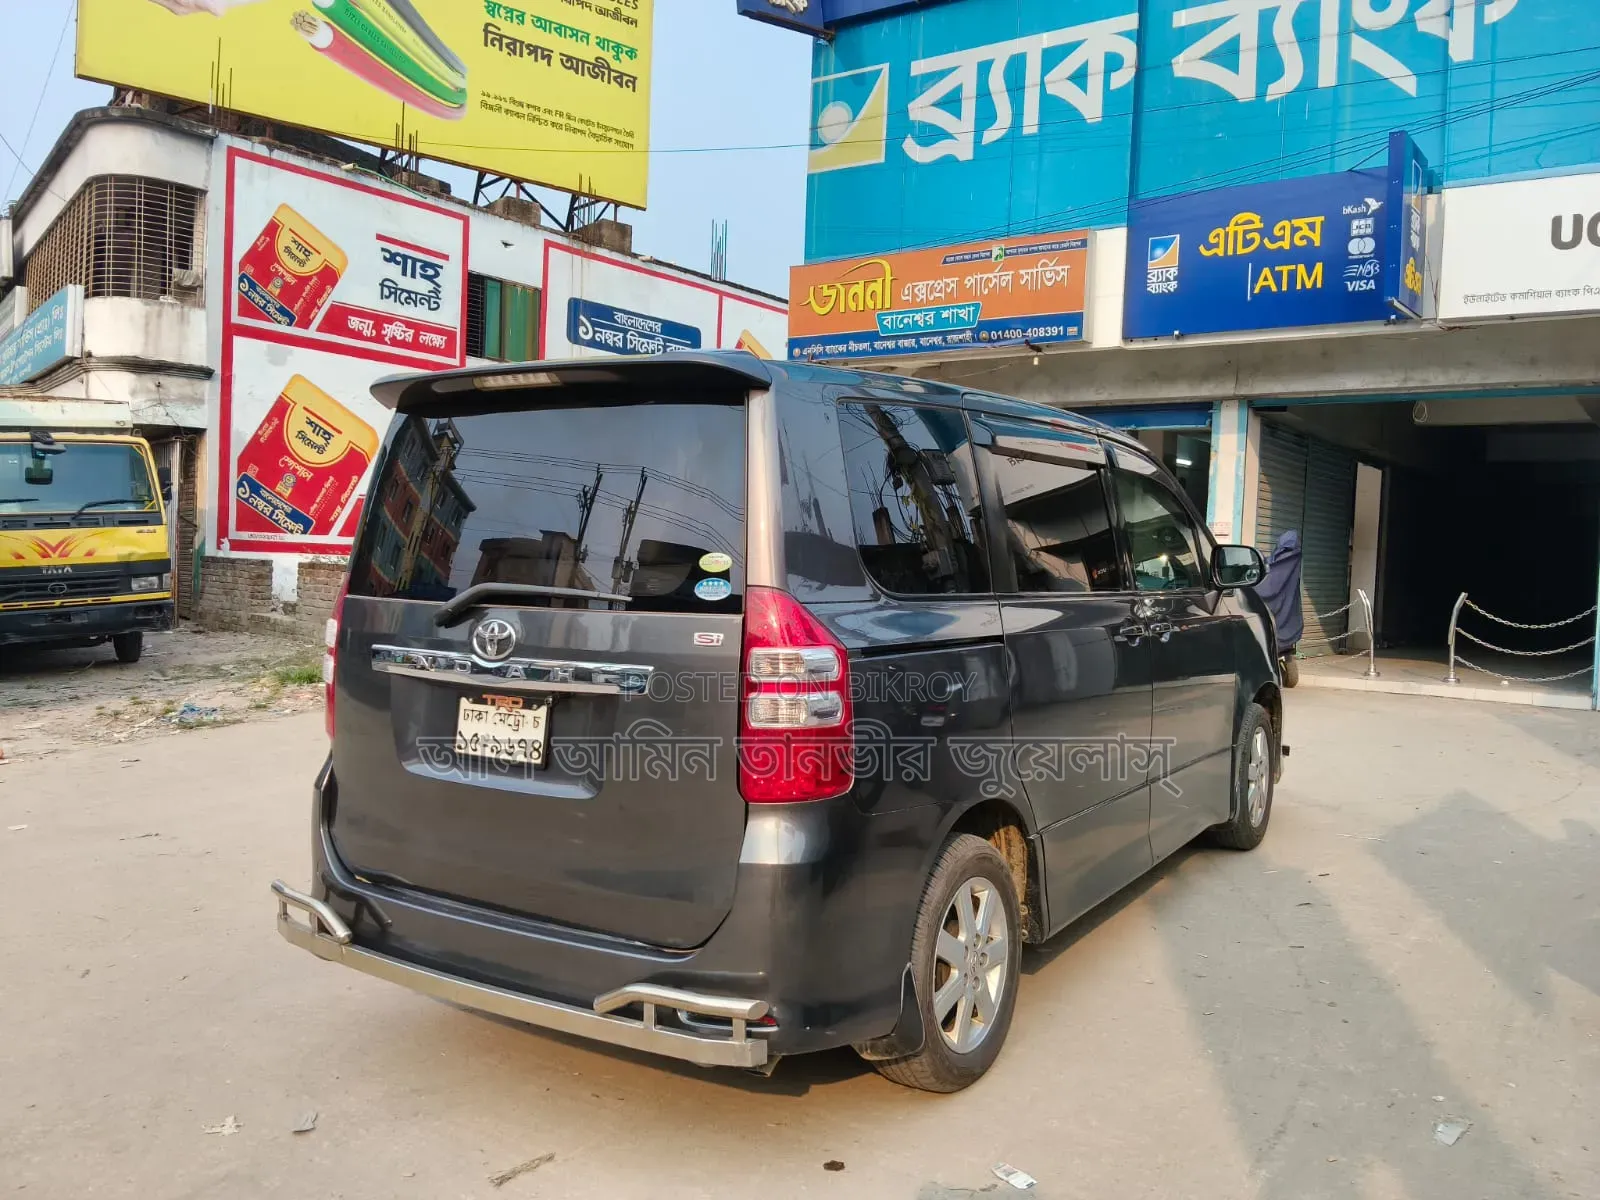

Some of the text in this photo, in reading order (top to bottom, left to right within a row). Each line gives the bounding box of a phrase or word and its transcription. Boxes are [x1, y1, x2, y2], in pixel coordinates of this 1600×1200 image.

[595, 5, 638, 28] আজীবন
[484, 0, 638, 62] স্বপ্নের আবাসন থাকুক
[483, 22, 638, 92] নিরাপদ আজীবন
[902, 13, 1139, 162] ব্র্যাক
[1343, 204, 1366, 215] bKash
[901, 277, 960, 304] এক্সপ্রেস
[964, 265, 1014, 297] পার্সেল
[1019, 257, 1071, 292] সার্ভিস
[1147, 267, 1178, 283] ব্র্যাক
[1253, 262, 1324, 294] ATM
[1344, 280, 1376, 292] VISA
[379, 277, 442, 311] সিমেন্ট
[1147, 281, 1178, 294] ব্যাংক
[613, 311, 662, 333] বাংলাদেশের
[883, 304, 975, 331] বানেশ্বর শাখা
[578, 314, 593, 340] ১
[594, 327, 624, 348] নম্বর
[990, 326, 1064, 340] 01400-408391
[695, 633, 723, 645] Si
[463, 708, 488, 724] ঢাকা
